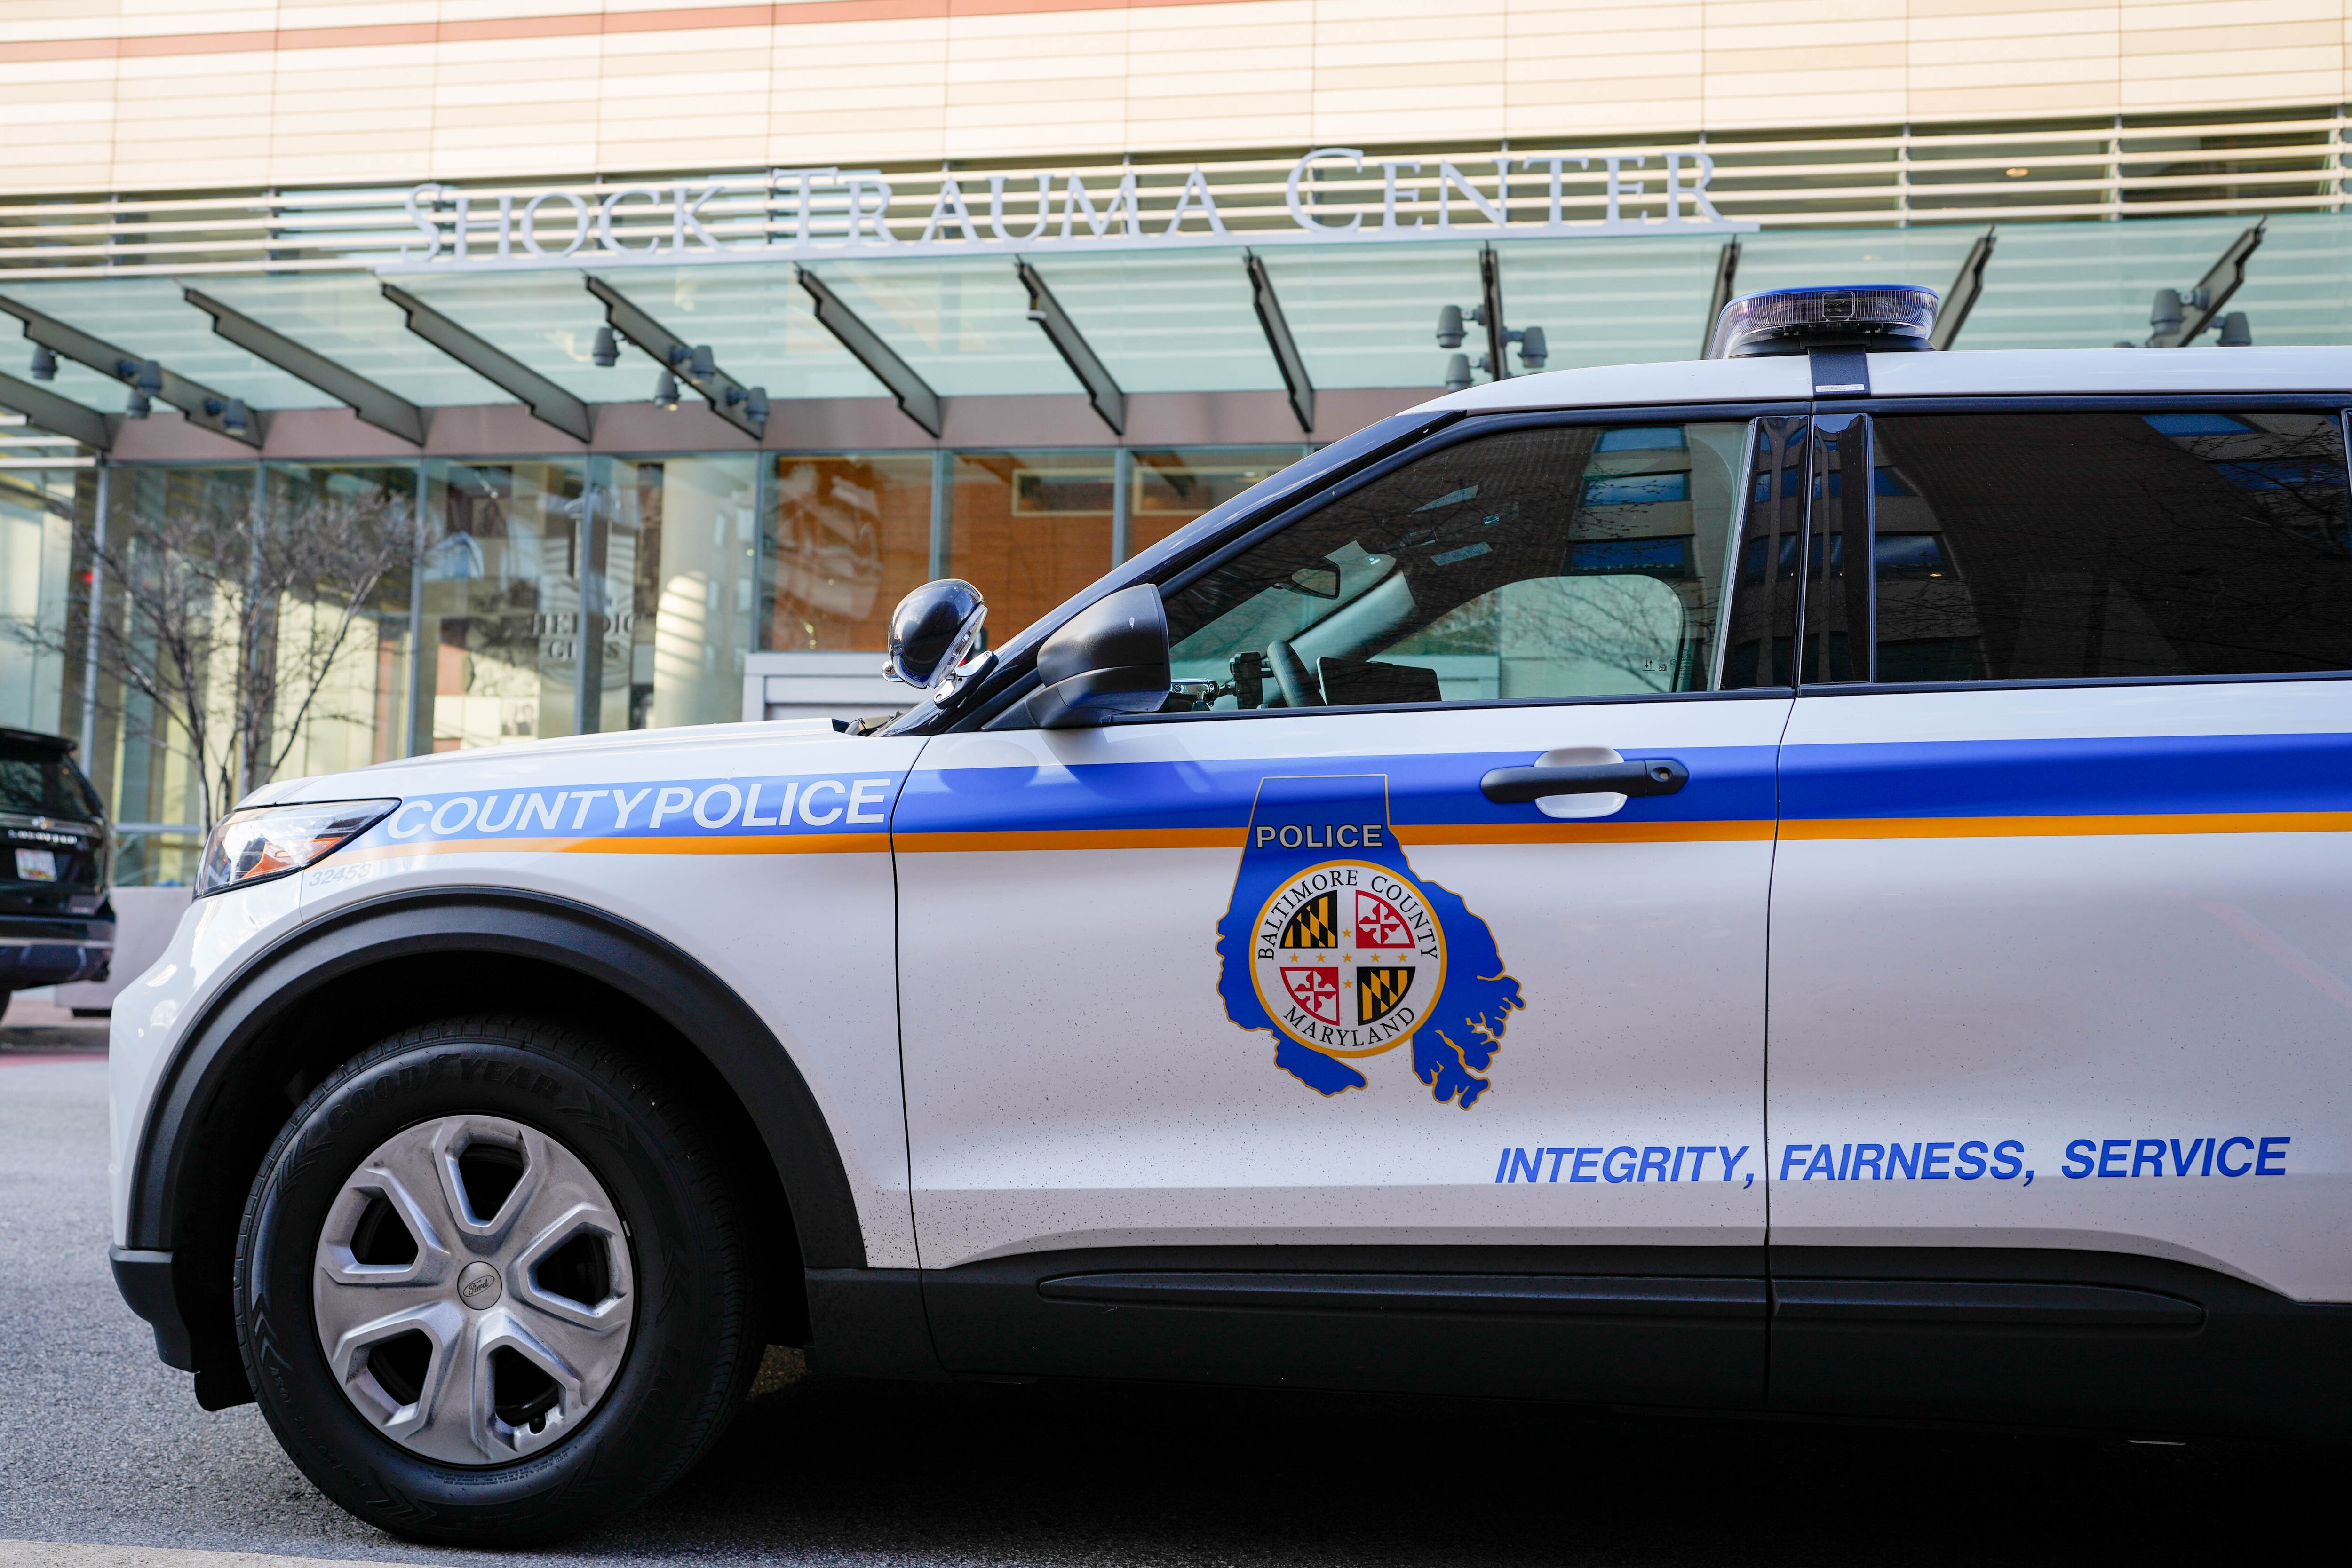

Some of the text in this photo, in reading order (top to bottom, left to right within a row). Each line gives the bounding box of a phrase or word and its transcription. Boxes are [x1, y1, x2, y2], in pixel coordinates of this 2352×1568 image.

[1255, 823, 1384, 848] POLICE
[1258, 869, 1439, 961] BALTIMORE COUNTY
[1283, 1006, 1415, 1047] MARYLAND
[1495, 1136, 2291, 1189] INTEGRITY, FAIRNESS, SERVICE
[469, 1279, 489, 1295] Ford
